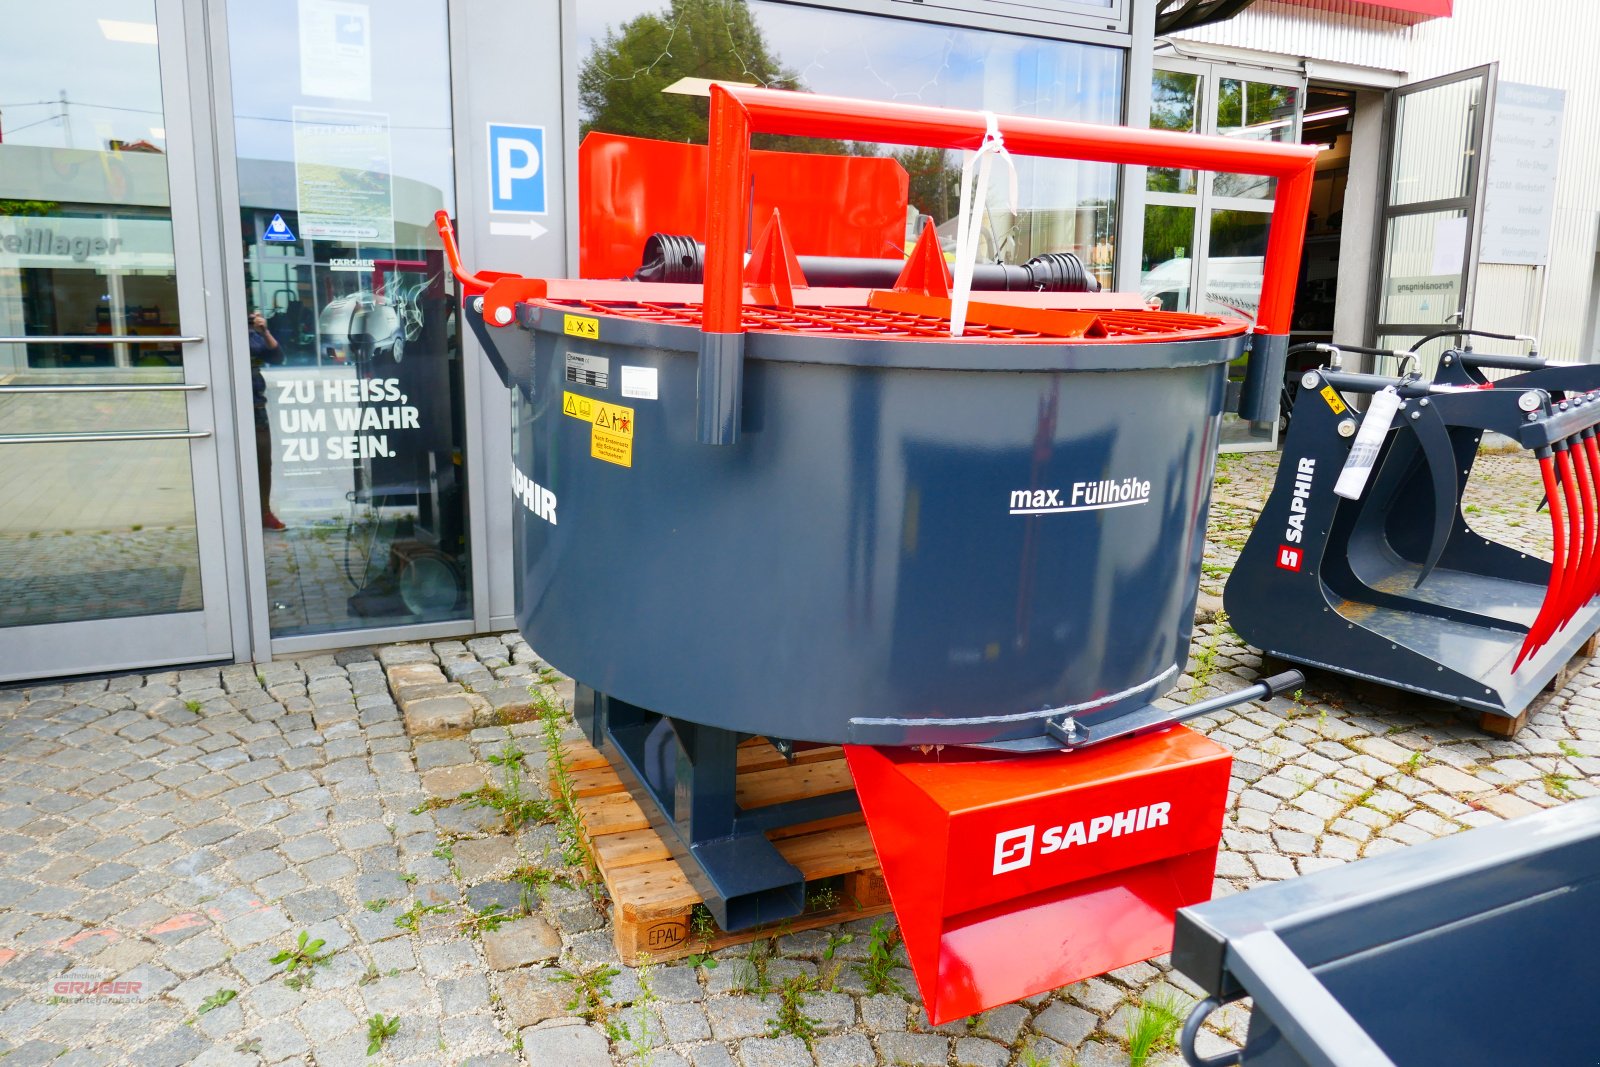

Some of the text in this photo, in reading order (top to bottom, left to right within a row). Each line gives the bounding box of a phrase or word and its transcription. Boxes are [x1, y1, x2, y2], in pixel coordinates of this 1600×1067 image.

[497, 137, 540, 200] P
[277, 378, 408, 404] ZU HEISS,
[280, 406, 420, 433] UM WAHR
[281, 435, 396, 462] ZU SEIN.
[511, 462, 557, 525] PHIR
[1010, 477, 1151, 508] max. Füllhöhe
[1285, 457, 1316, 543] SAPHIR
[1040, 801, 1171, 855] SAPHIR
[648, 927, 682, 946] EPAL
